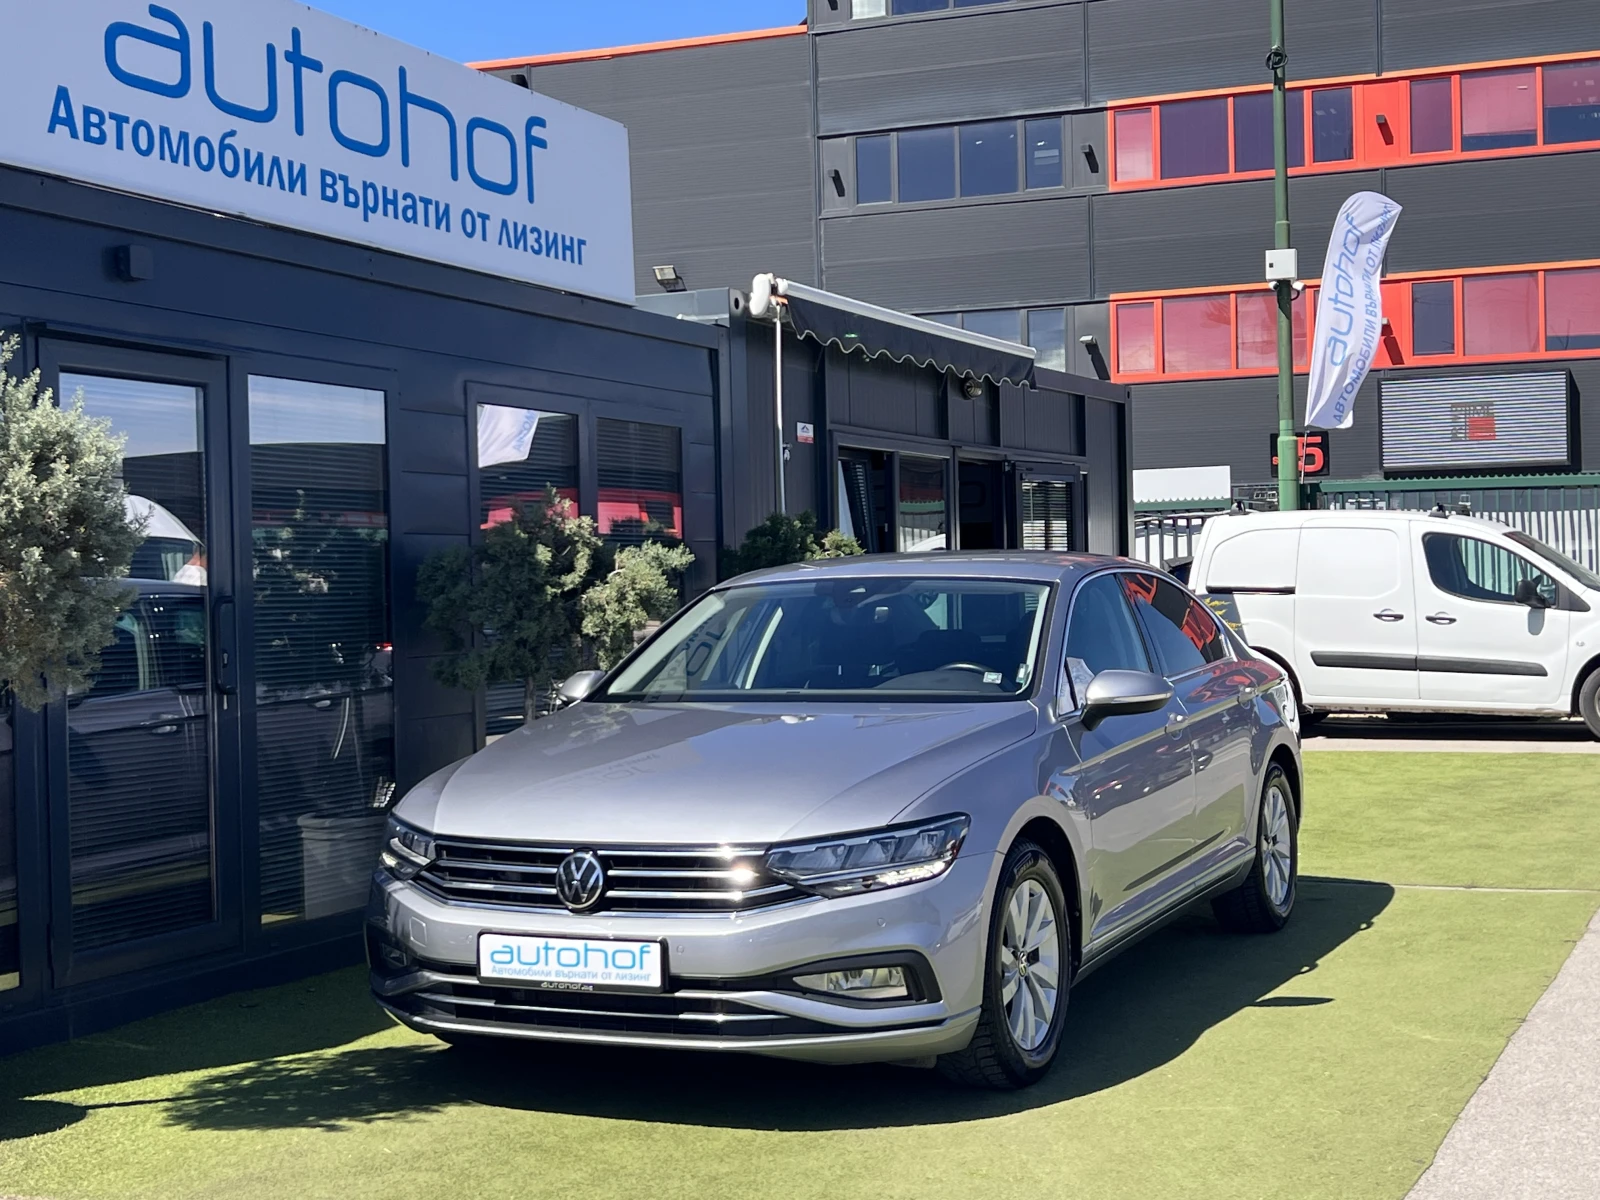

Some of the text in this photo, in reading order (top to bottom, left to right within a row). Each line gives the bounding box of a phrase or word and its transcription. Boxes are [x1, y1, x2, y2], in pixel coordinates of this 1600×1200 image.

[47, 85, 588, 266] Автомобили върнати от лизинг
[104, 3, 548, 204] autohof
[1327, 213, 1364, 367] autohof
[1333, 318, 1377, 424] АВТОМОБИЛИ
[1366, 249, 1378, 269] ОТ
[1297, 436, 1324, 473] 5
[490, 941, 651, 970] autohof
[491, 965, 651, 981] Автомобили върнати от лизинг
